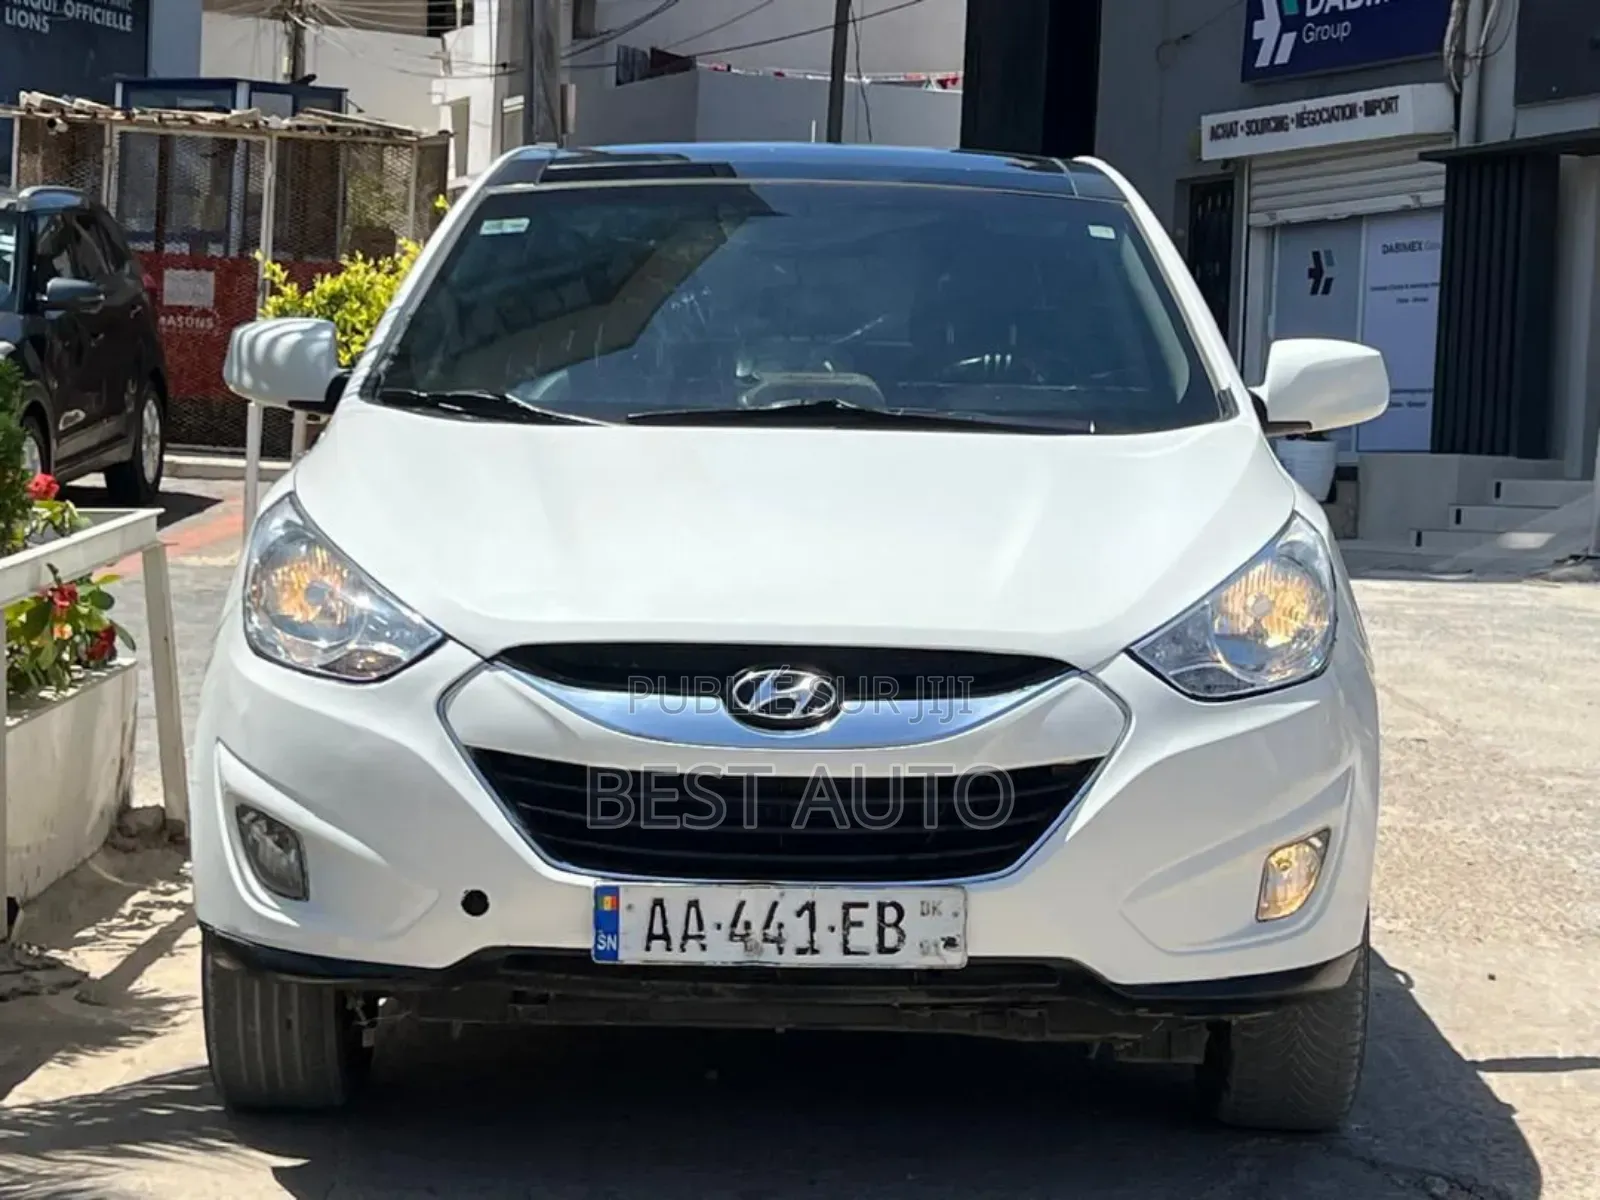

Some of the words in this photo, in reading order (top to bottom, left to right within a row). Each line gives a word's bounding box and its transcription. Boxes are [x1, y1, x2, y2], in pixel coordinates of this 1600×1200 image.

[5, 6, 50, 34] LIONS
[64, 0, 132, 32] OFFICIELLE
[1302, 21, 1351, 44] Group
[1210, 120, 1240, 142] ACHAT
[1245, 114, 1290, 137] SOURCING
[1295, 104, 1358, 129] NÉGOCIATION
[1364, 95, 1400, 118] IMPORT
[596, 933, 618, 950] SN
